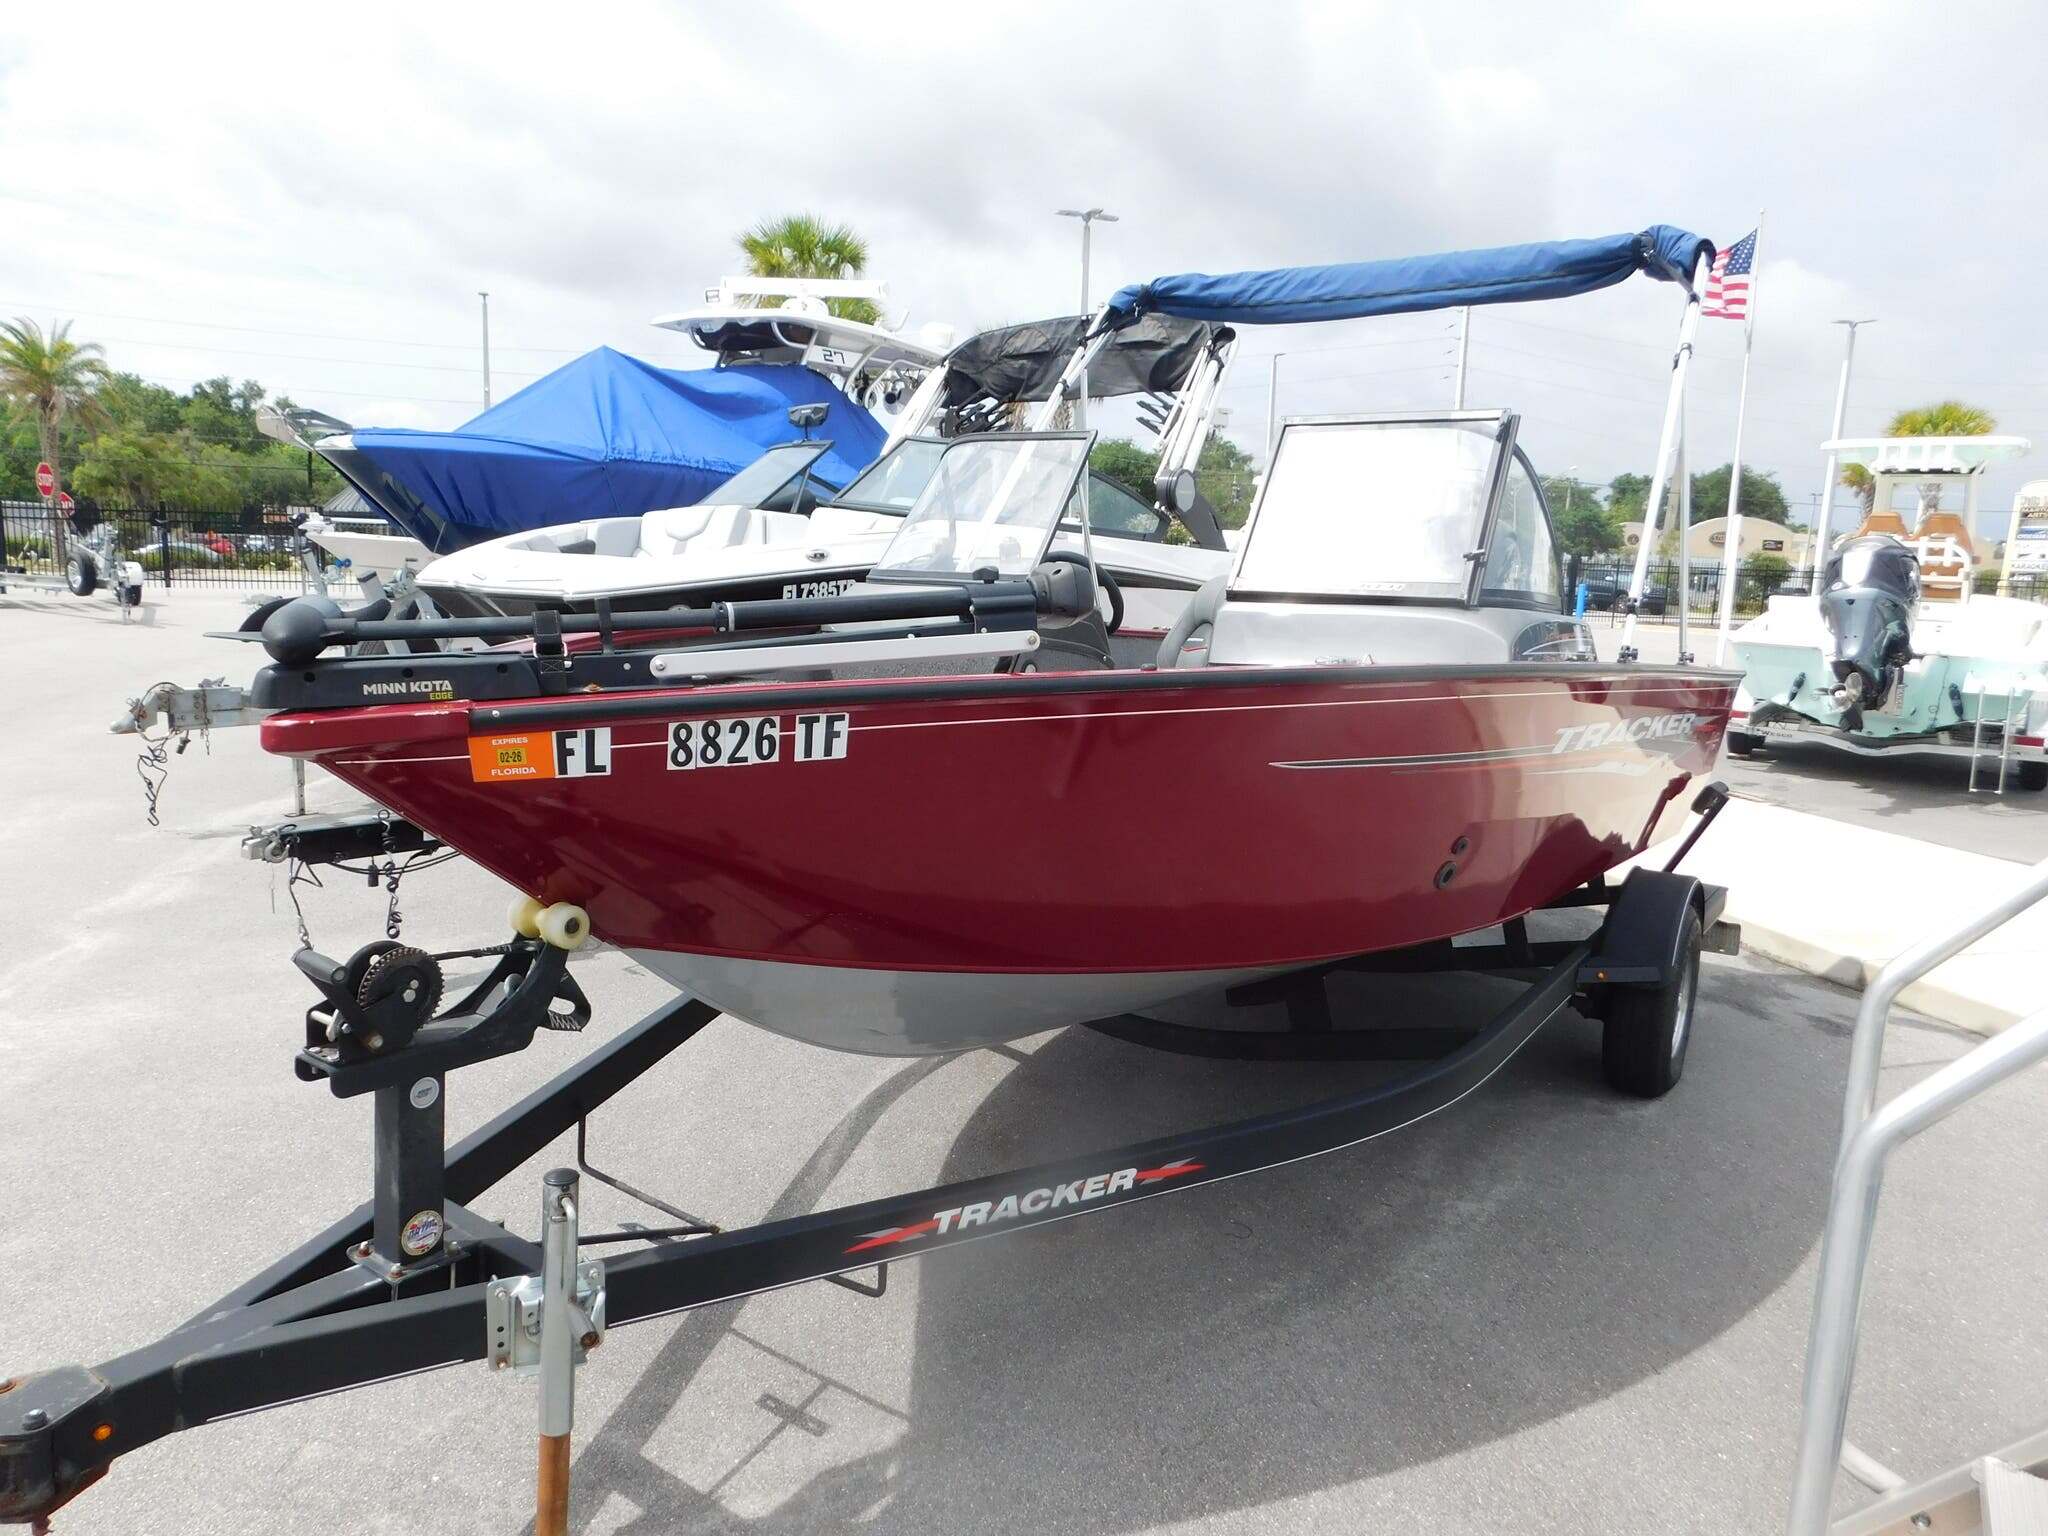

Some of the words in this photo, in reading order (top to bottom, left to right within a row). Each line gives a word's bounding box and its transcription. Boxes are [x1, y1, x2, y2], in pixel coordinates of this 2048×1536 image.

[822, 350, 845, 364] 27
[38, 473, 53, 487] STOP
[363, 682, 407, 696] MINN
[410, 680, 453, 692] KOTA
[429, 692, 454, 700] EDGE
[491, 736, 529, 746] EXPIRES
[1552, 713, 1697, 755] TRACKER
[555, 729, 607, 776] FL
[670, 717, 777, 768] 8826
[798, 714, 846, 759] TF
[499, 751, 523, 763] 02-26
[490, 766, 537, 777] FLORIDA
[932, 1167, 1138, 1236] TRACKER
